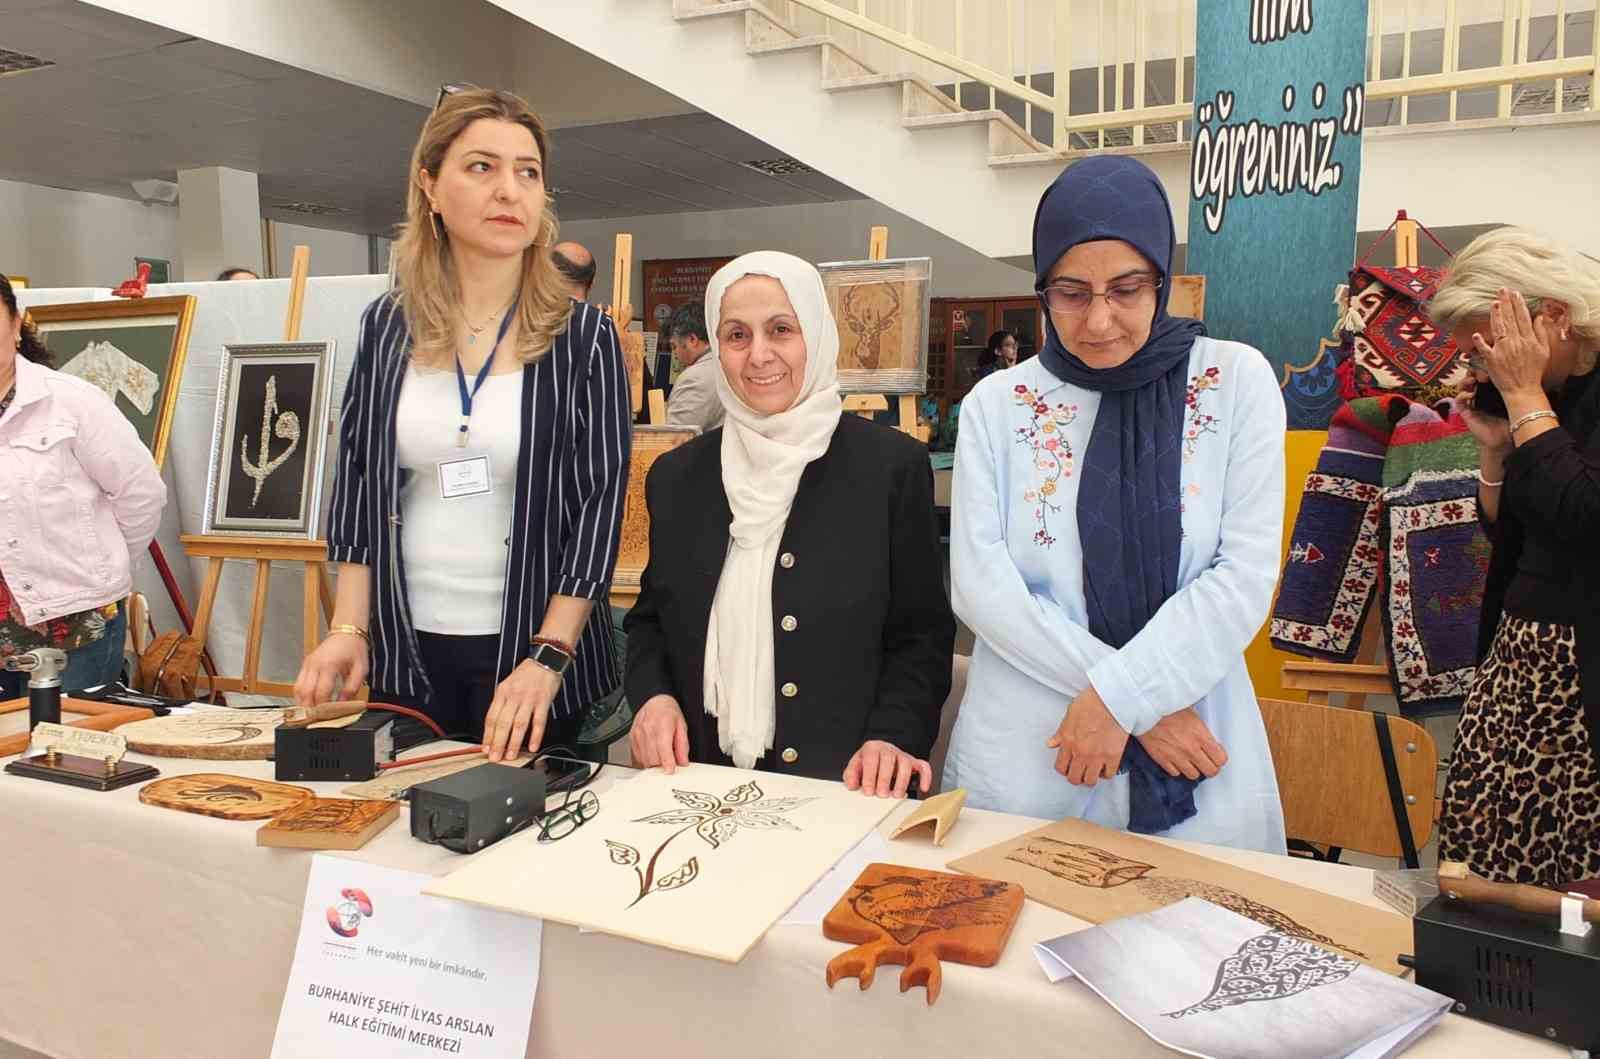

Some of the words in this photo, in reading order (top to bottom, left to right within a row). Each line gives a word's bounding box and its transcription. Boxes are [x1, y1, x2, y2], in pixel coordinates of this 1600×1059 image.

[366, 945, 383, 957] Her
[428, 957, 442, 970] bir
[308, 983, 376, 1010] BURHANİYE
[376, 999, 410, 1017] ŞEHİT
[410, 1003, 443, 1026] İLYAS
[445, 1016, 495, 1038] ARSLAN
[328, 1011, 360, 1029] HALK
[361, 1017, 407, 1041] EĞİTİMİ
[408, 1029, 462, 1054] MERKEZİ
